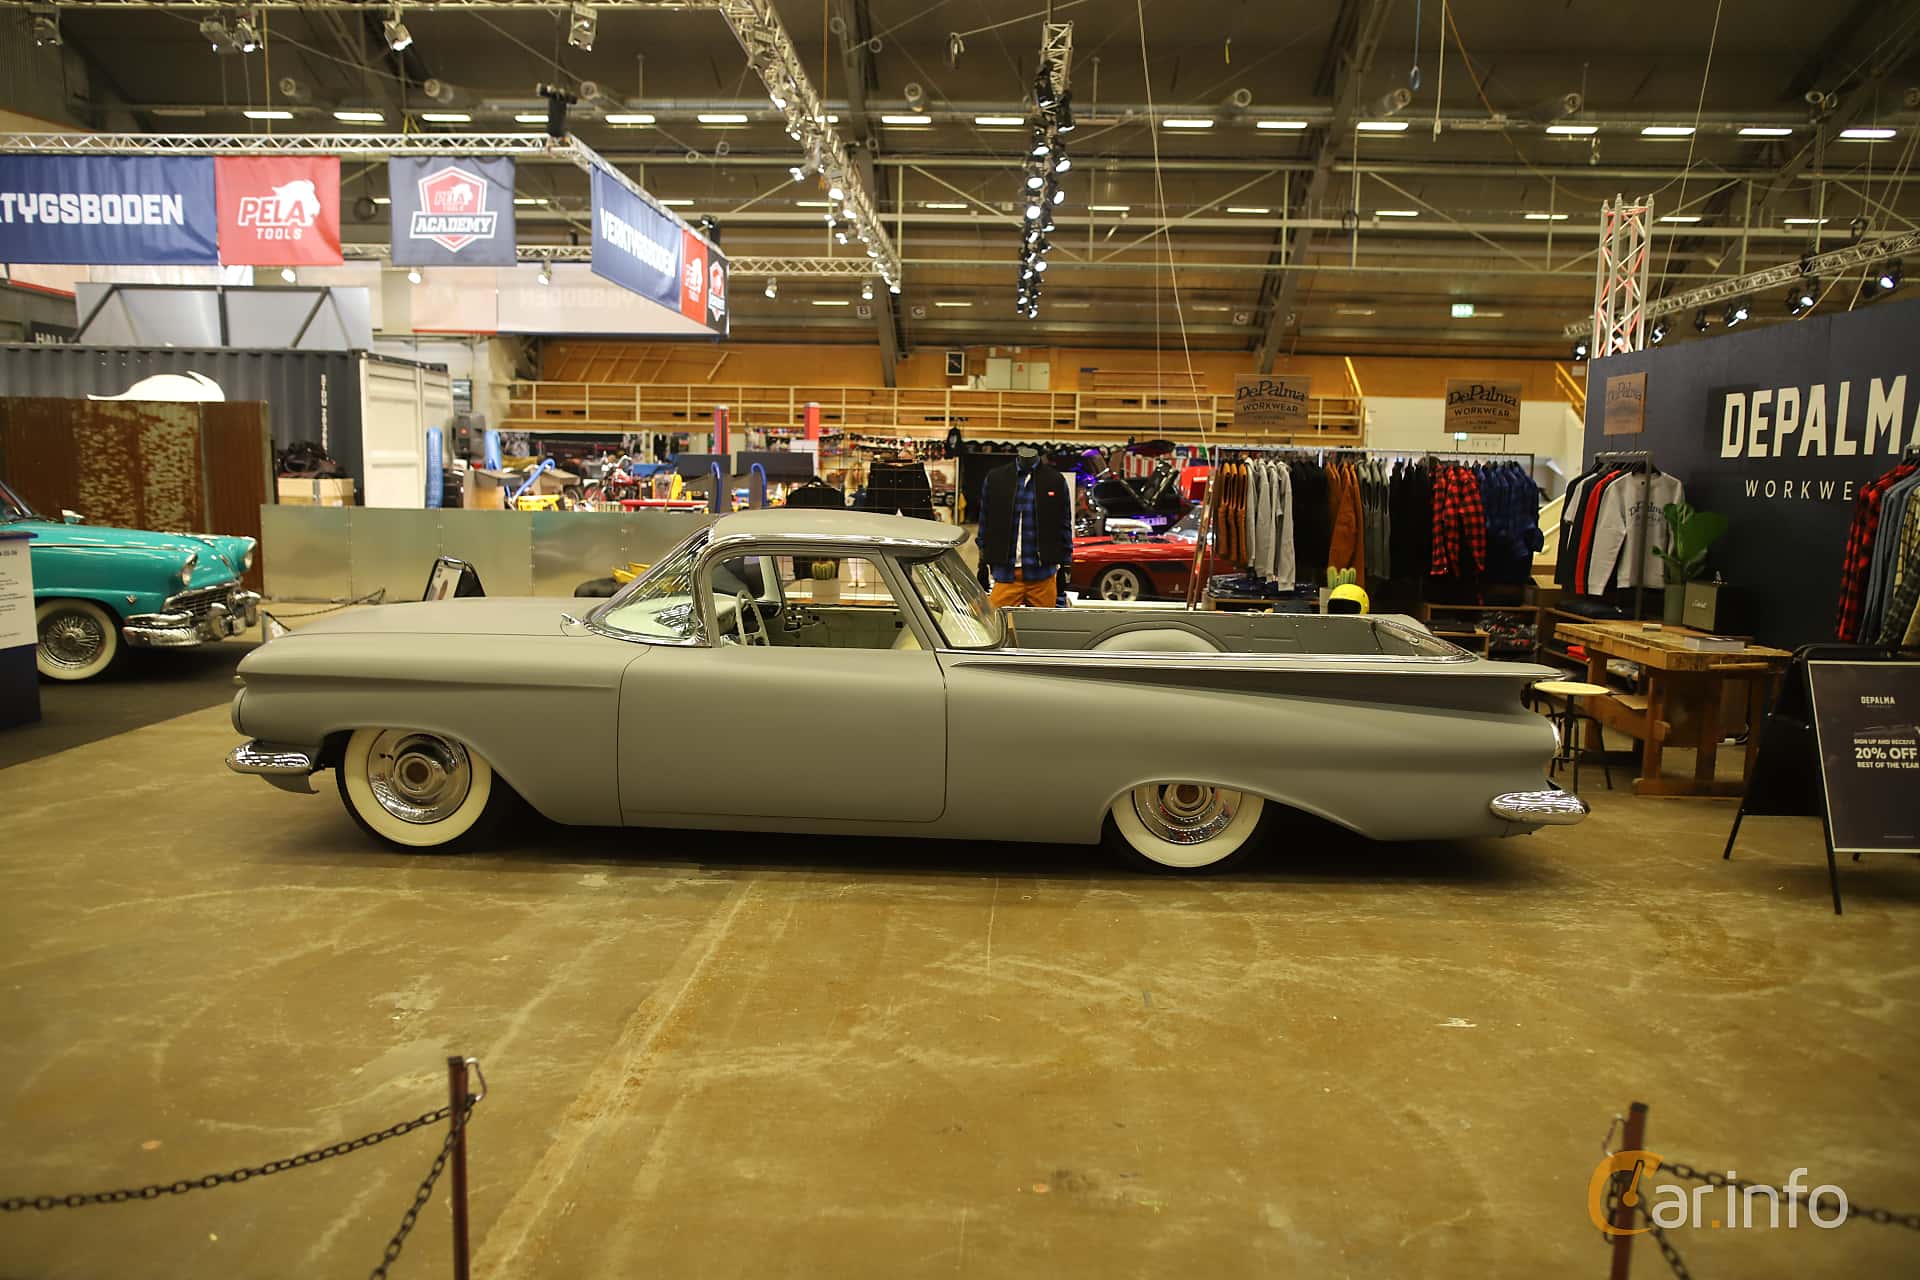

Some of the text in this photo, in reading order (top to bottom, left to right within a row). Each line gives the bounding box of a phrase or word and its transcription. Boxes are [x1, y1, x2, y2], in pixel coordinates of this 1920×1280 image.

[0, 193, 184, 225] TYGSBODEN
[238, 196, 312, 226] PELA
[256, 227, 302, 239] TOOLS
[415, 216, 492, 233] ACADEMY
[1237, 380, 1305, 401] DePalma
[1448, 384, 1517, 406] DePalma
[1243, 402, 1299, 413] WORKWEAR
[1454, 407, 1511, 417] WORKWEAR
[1745, 479, 1854, 501] WORKWE
[1860, 696, 1896, 705] DEPALMA
[1854, 747, 1918, 760] 20% OFF
